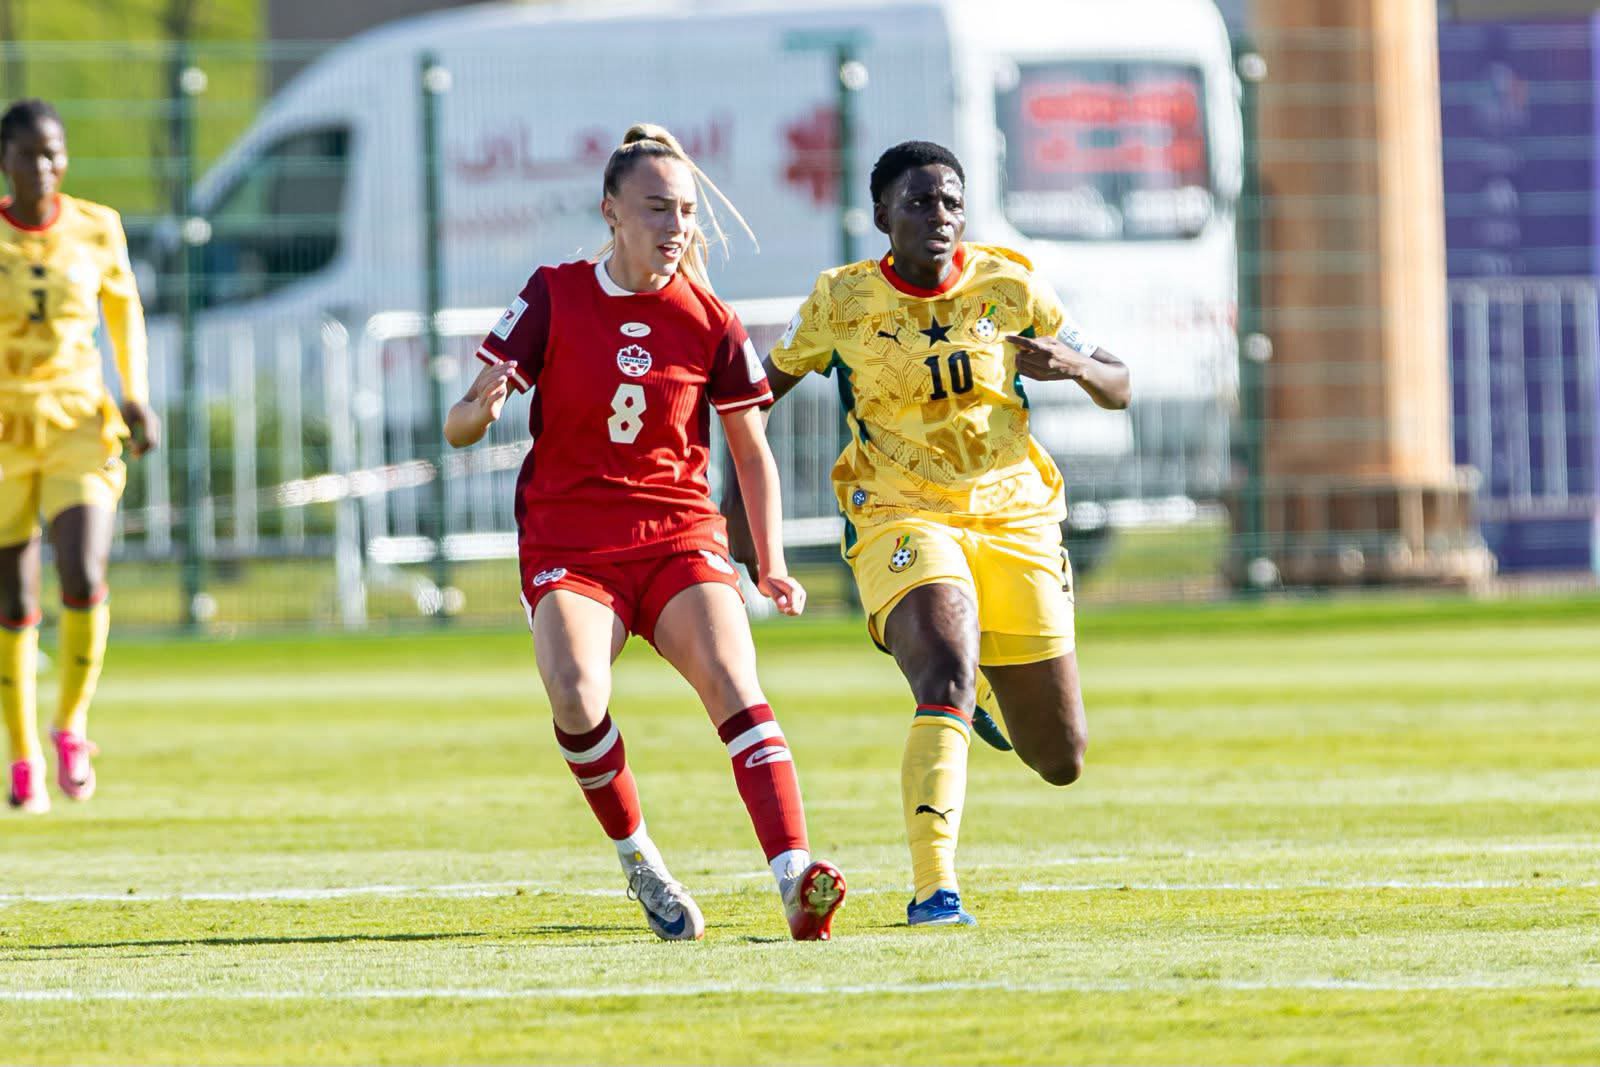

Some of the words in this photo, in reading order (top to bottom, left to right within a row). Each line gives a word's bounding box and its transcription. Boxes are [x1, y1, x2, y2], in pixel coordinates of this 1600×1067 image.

[29, 288, 47, 323] 3
[619, 356, 649, 365] CANADA
[924, 350, 974, 400] 10
[608, 383, 647, 444] 8
